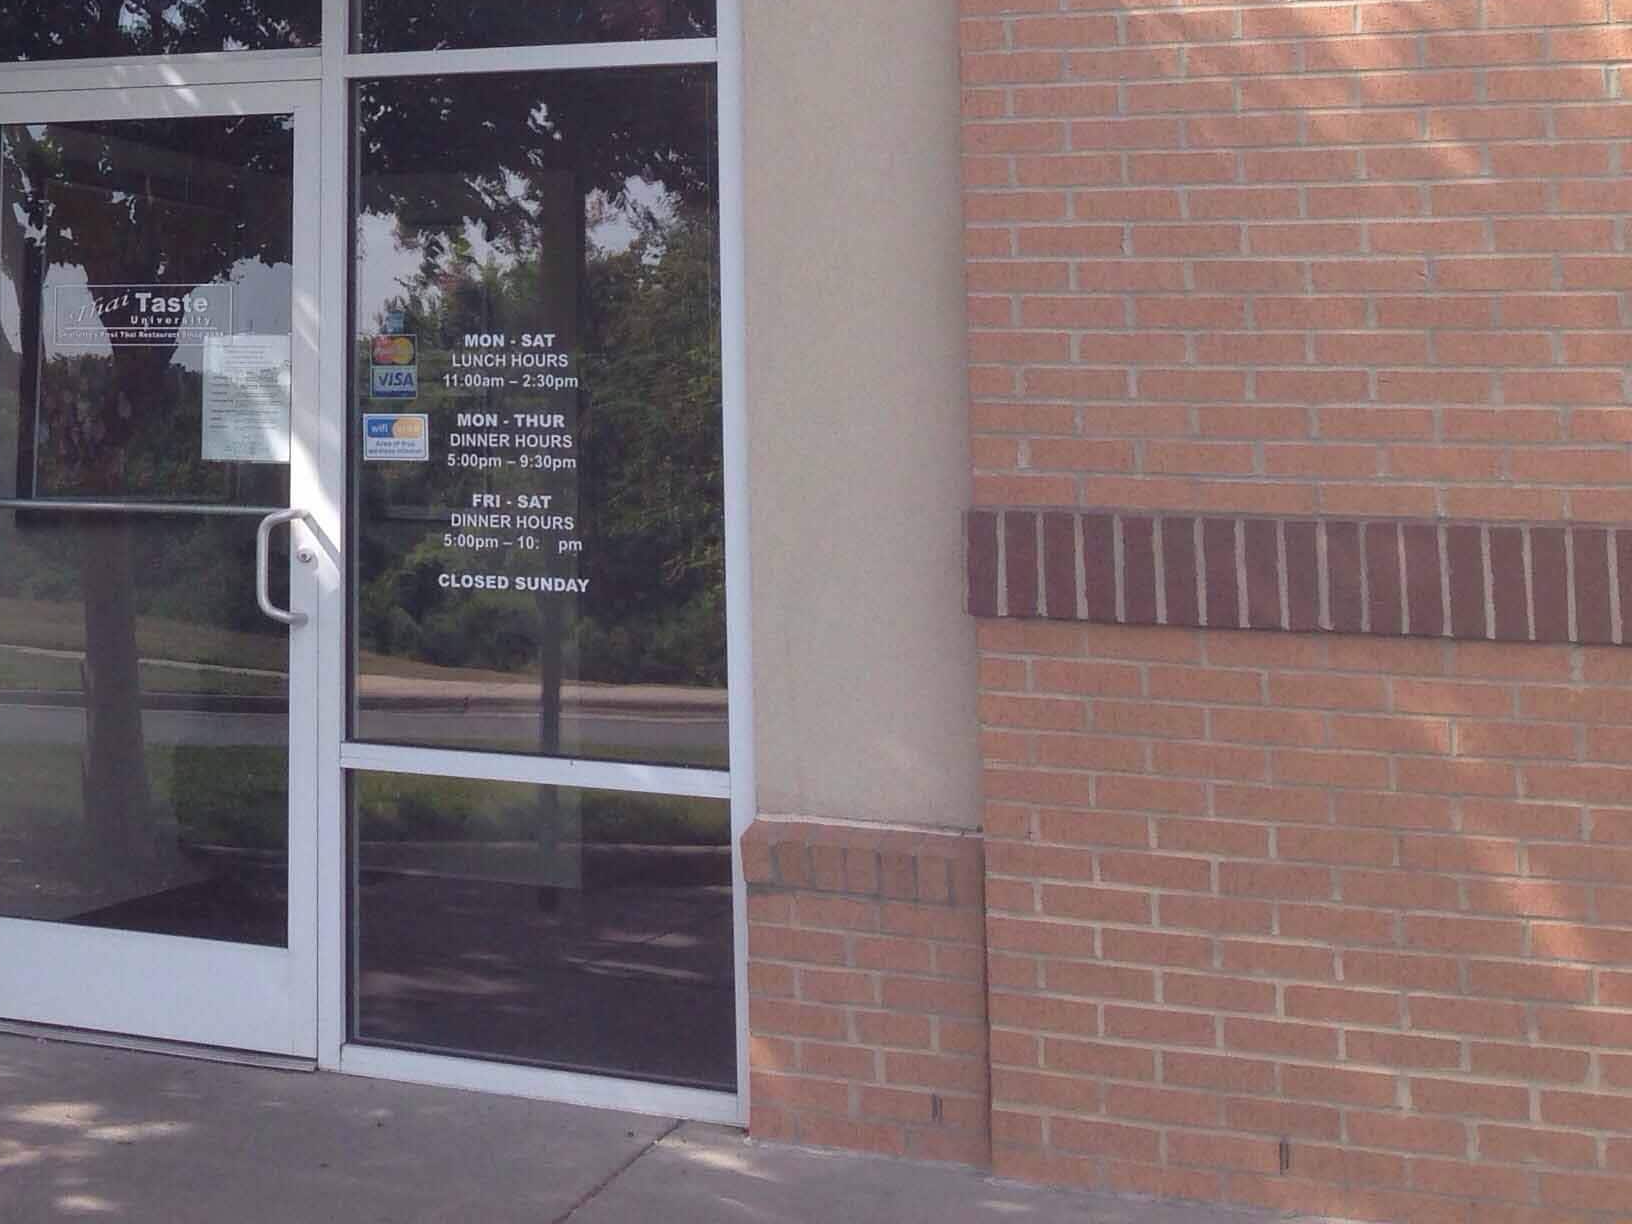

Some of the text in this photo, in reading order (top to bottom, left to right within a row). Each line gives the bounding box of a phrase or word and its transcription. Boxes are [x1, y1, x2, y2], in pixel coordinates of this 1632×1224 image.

[135, 292, 209, 313] Taste
[130, 314, 210, 326] University
[464, 334, 506, 348] MON
[521, 334, 556, 348] SAT
[451, 353, 569, 368] LUNCH HOURS
[378, 372, 414, 387] VISA
[443, 374, 505, 388] 11:00am
[522, 374, 579, 390] 2:30pm
[457, 413, 501, 428] MON
[514, 414, 565, 428] THUR
[450, 434, 573, 449] DINNER HOURS
[447, 454, 502, 471] 5:00pm
[519, 455, 576, 472] 9:30pm
[472, 494, 501, 508] FRI
[517, 494, 552, 509] SAT
[451, 514, 575, 530] DINNER HOURS
[443, 534, 499, 550] 5:00pm
[438, 574, 590, 593] CLOSED SUNDAY
